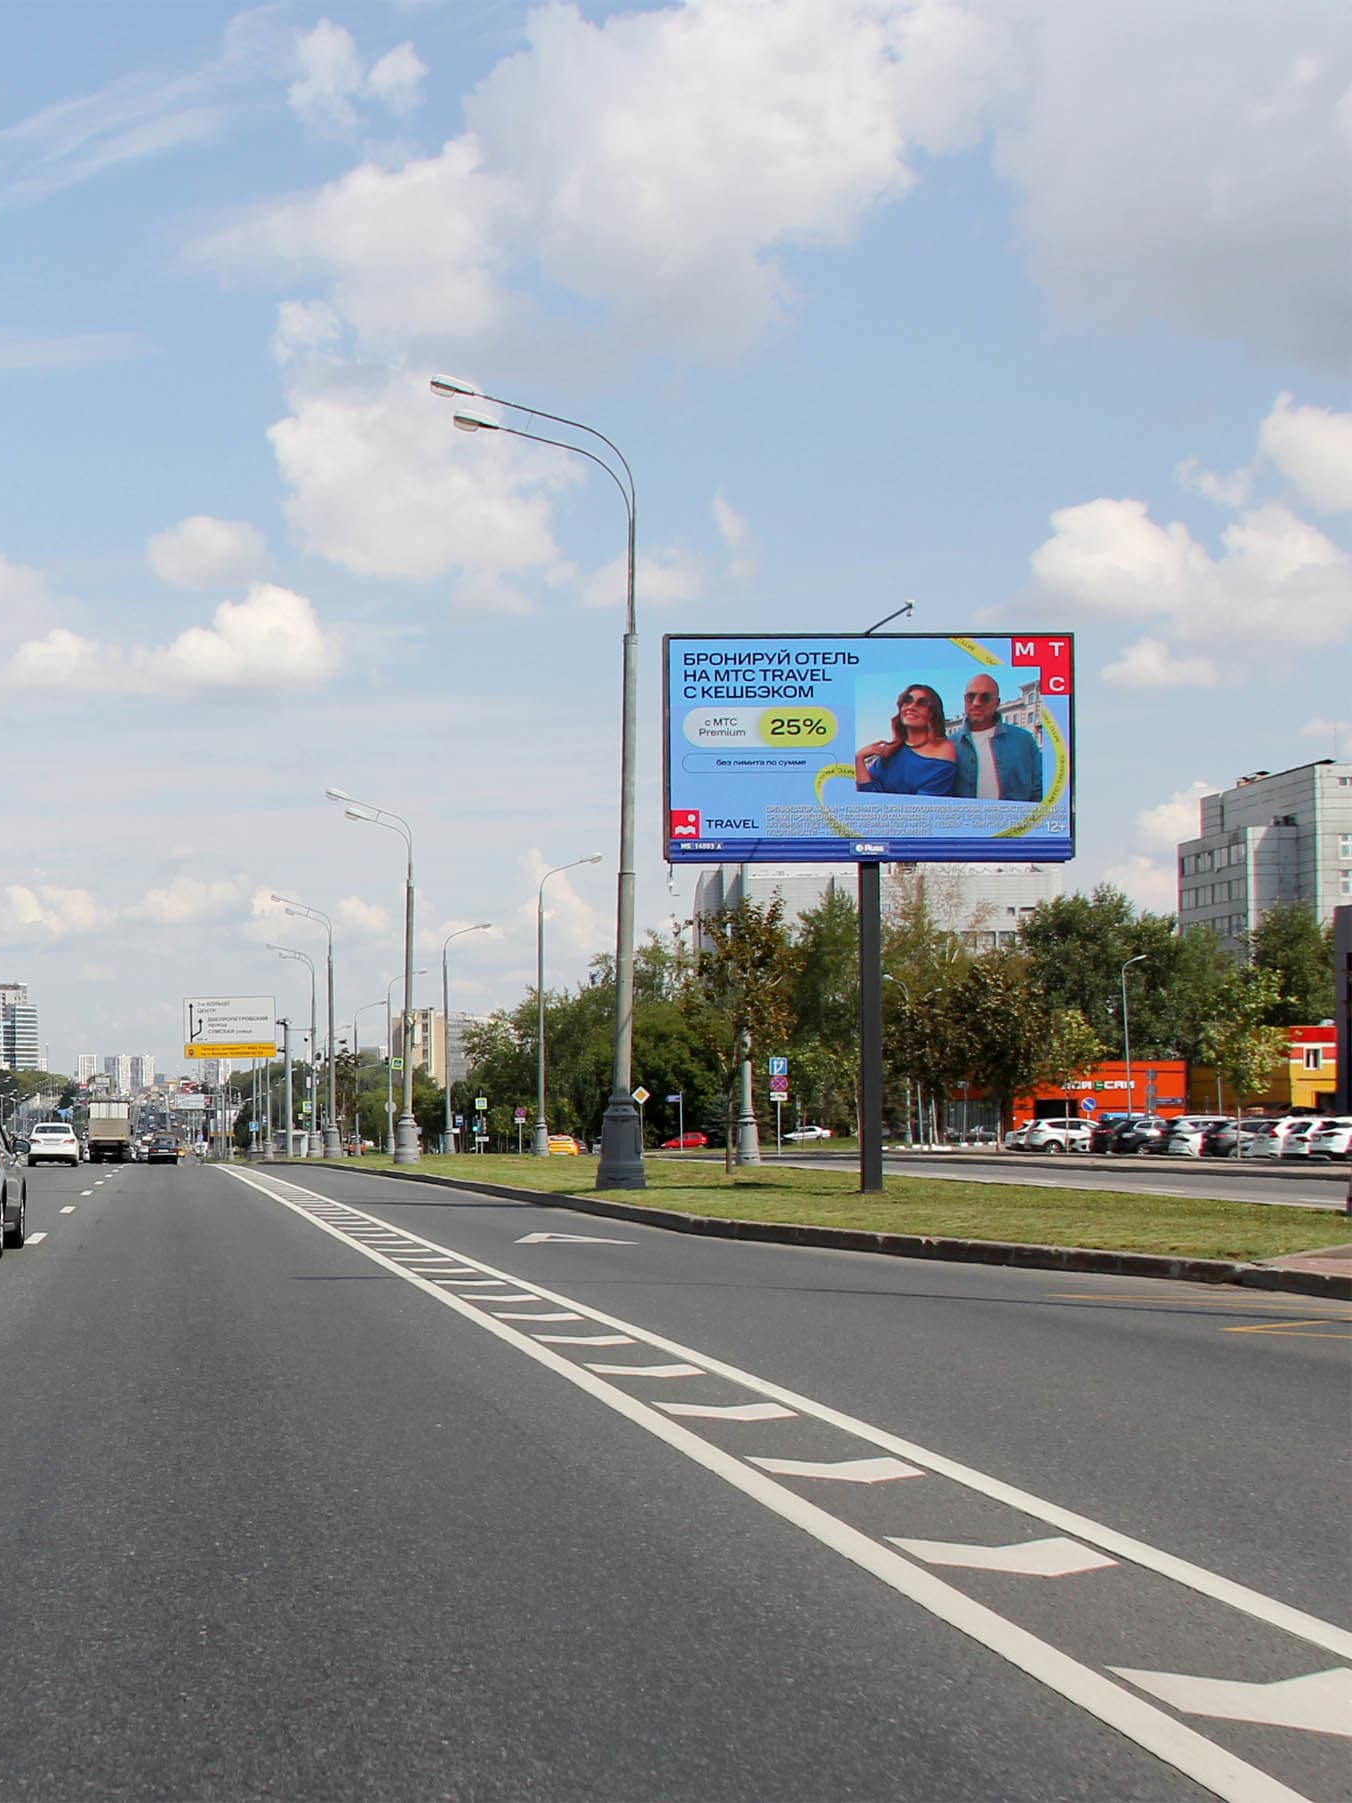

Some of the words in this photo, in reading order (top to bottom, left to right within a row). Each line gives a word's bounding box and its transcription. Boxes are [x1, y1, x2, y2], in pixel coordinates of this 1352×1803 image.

[683, 650, 790, 665] БРОНИРУЙ
[795, 652, 859, 665] ОТЕЛЬ
[683, 669, 711, 682] НА
[715, 669, 755, 682] МТС
[759, 669, 832, 682] TRAVEL
[683, 686, 697, 699] С
[701, 686, 814, 699] КЕШБЭКОМ
[713, 718, 737, 726] МТС
[770, 718, 827, 736] 25%
[699, 728, 746, 737] Premium
[706, 819, 759, 829] TRAVEL
[1047, 821, 1066, 833] 12+
[864, 844, 884, 852] Russ
